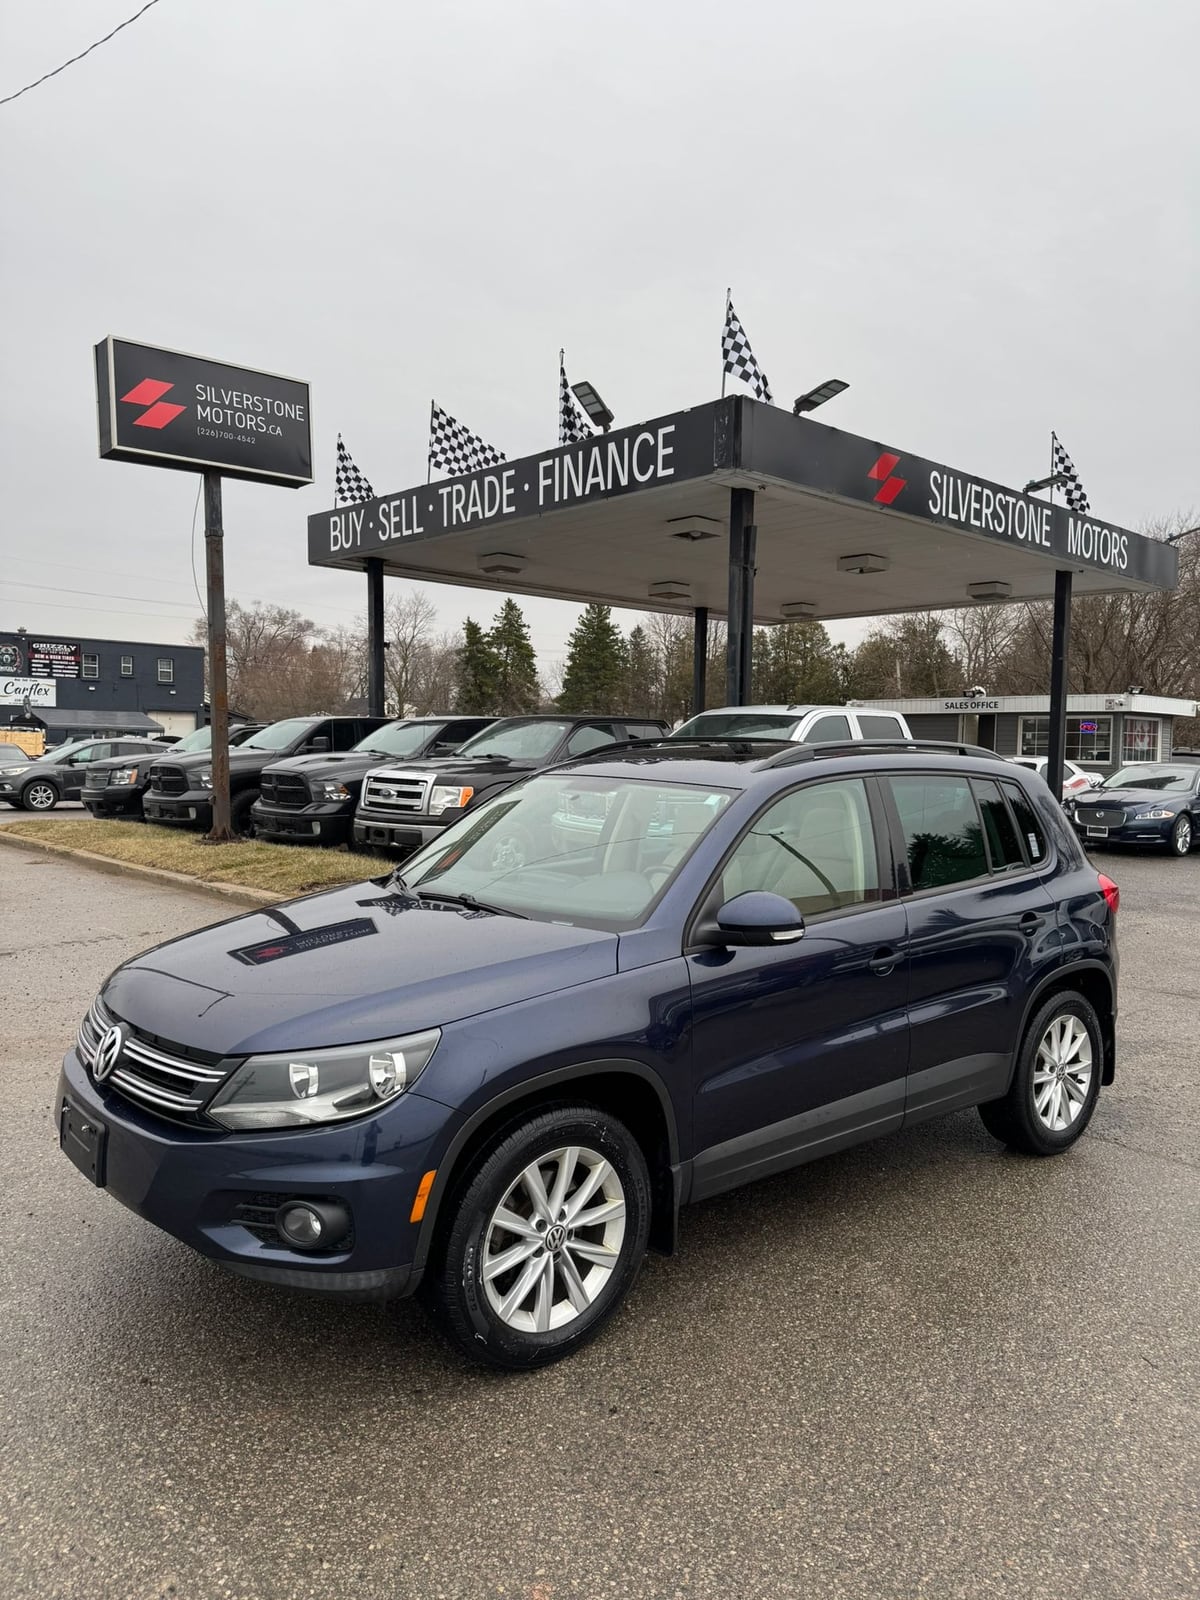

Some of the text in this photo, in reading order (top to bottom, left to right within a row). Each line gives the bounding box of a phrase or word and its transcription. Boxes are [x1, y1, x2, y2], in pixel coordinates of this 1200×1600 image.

[195, 384, 305, 422] SILVERSTONE
[329, 425, 676, 552] BUY SELL TRADE FINANCE
[928, 470, 1128, 570] SILVERSTONE MOTORS
[4, 680, 50, 697] Carflex
[970, 701, 999, 709] OFFICE
